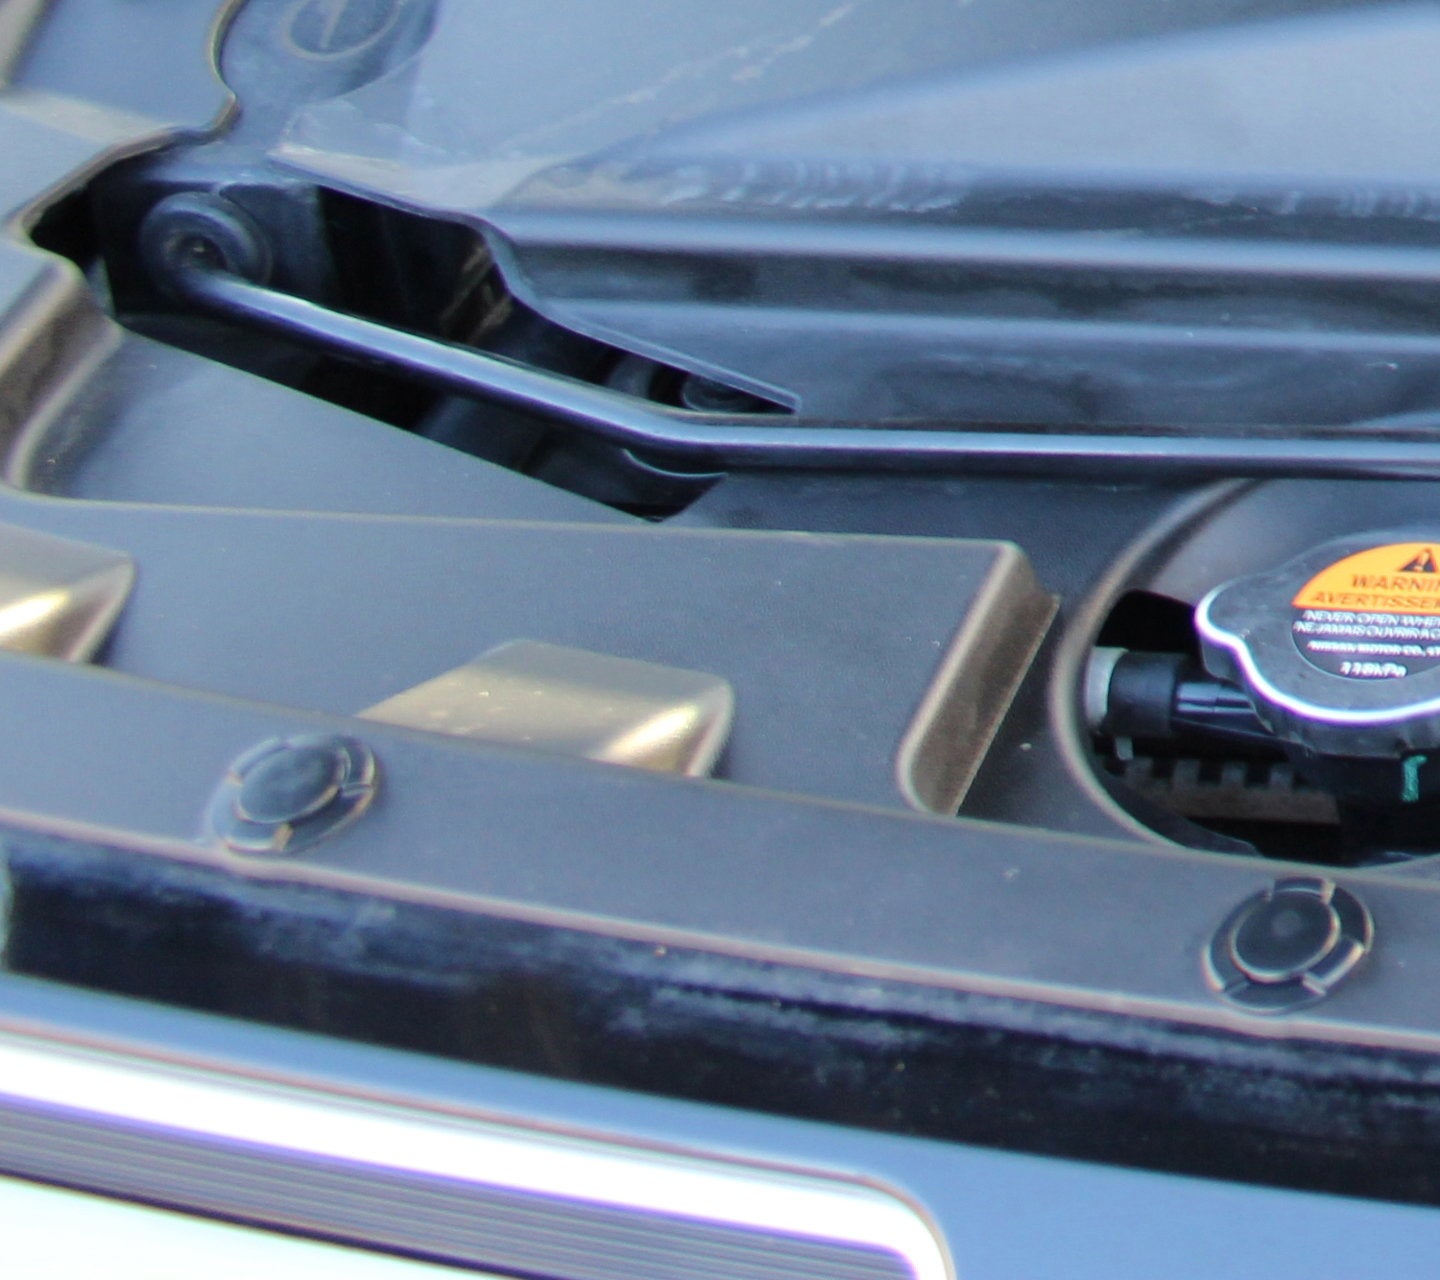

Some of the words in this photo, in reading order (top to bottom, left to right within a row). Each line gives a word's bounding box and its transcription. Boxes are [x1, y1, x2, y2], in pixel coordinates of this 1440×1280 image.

[1302, 609, 1355, 623] NEVER
[1356, 612, 1399, 625] OPEN
[1316, 623, 1365, 636] JAMAIS
[1357, 642, 1401, 654] MOTOR
